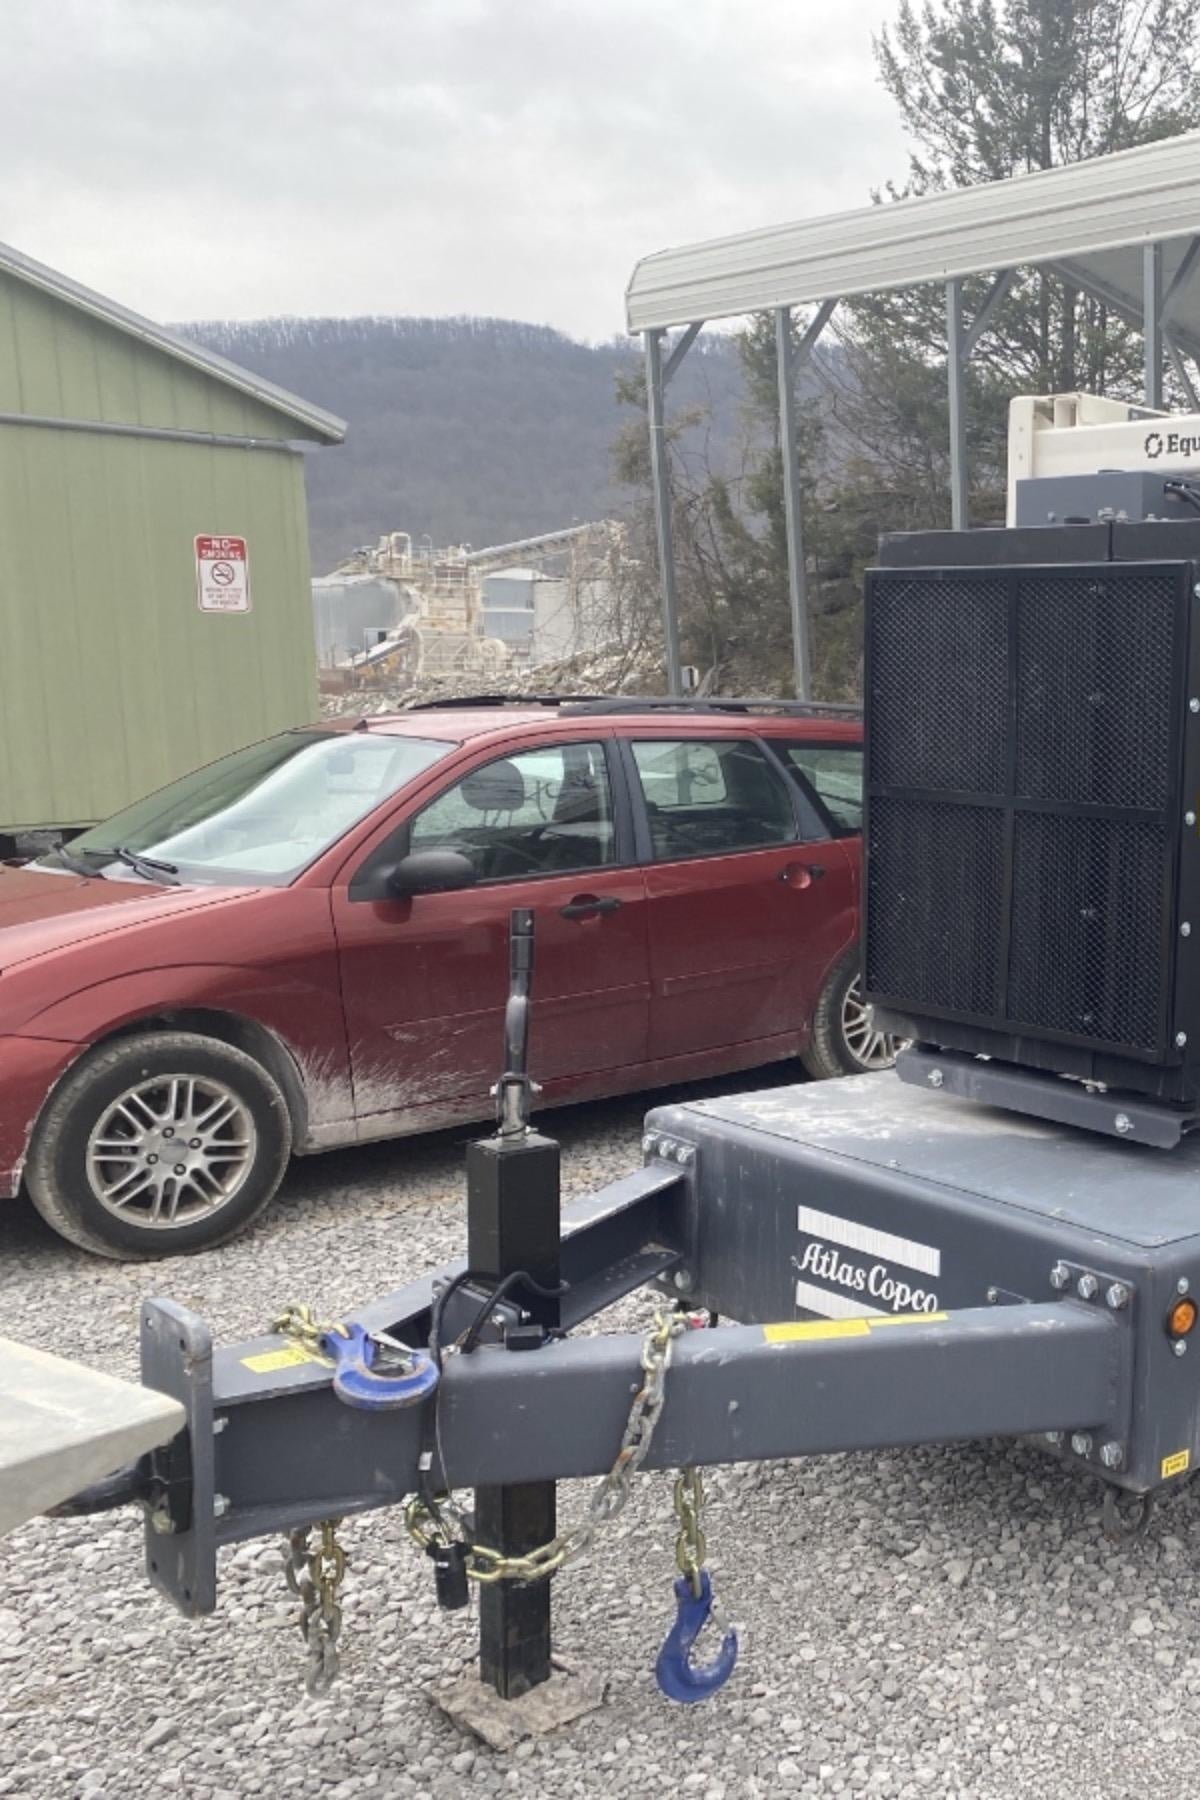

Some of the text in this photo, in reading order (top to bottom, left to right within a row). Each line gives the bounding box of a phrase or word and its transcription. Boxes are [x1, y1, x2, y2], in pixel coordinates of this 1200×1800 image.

[211, 539, 230, 549] NO
[790, 1242, 938, 1313] Atlas Copco
